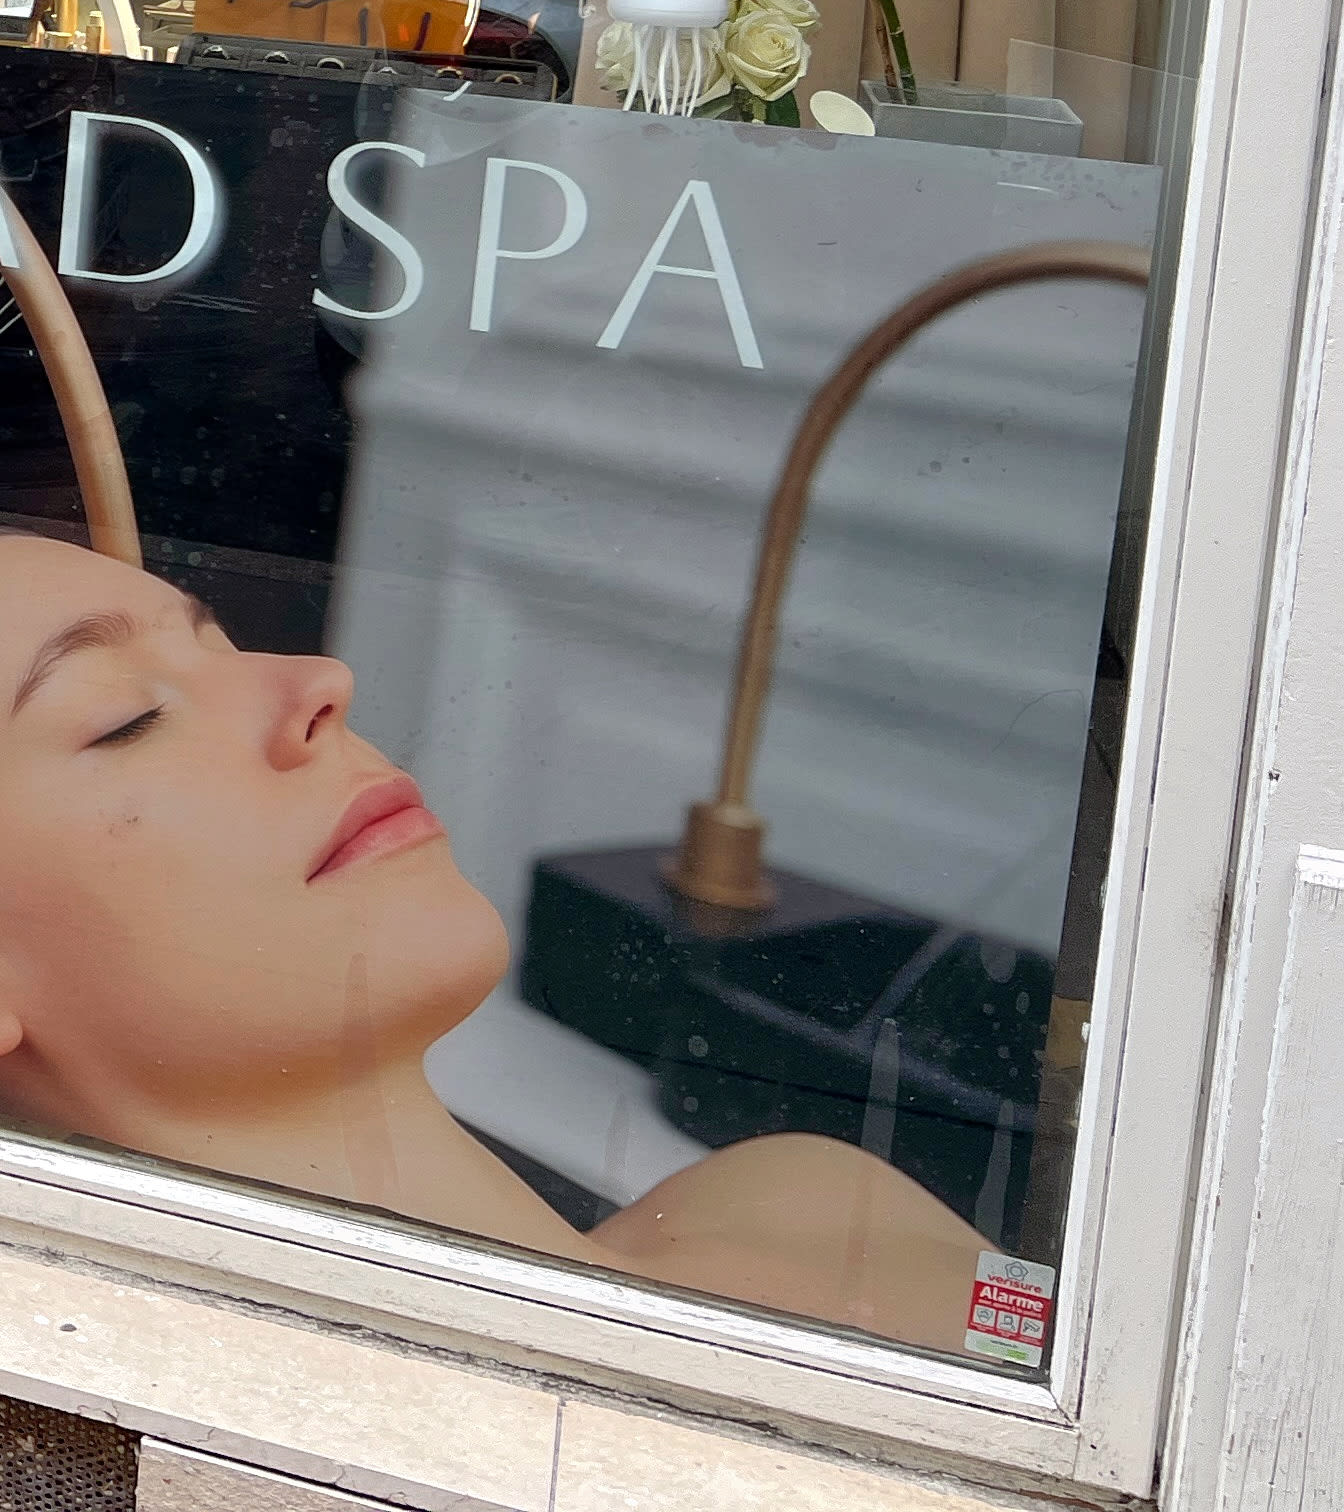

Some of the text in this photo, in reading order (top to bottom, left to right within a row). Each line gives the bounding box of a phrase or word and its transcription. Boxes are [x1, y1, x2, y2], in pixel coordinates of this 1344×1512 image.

[312, 138, 765, 371] SPA
[988, 1274, 1042, 1293] verisure
[980, 1286, 1043, 1312] Alarme
